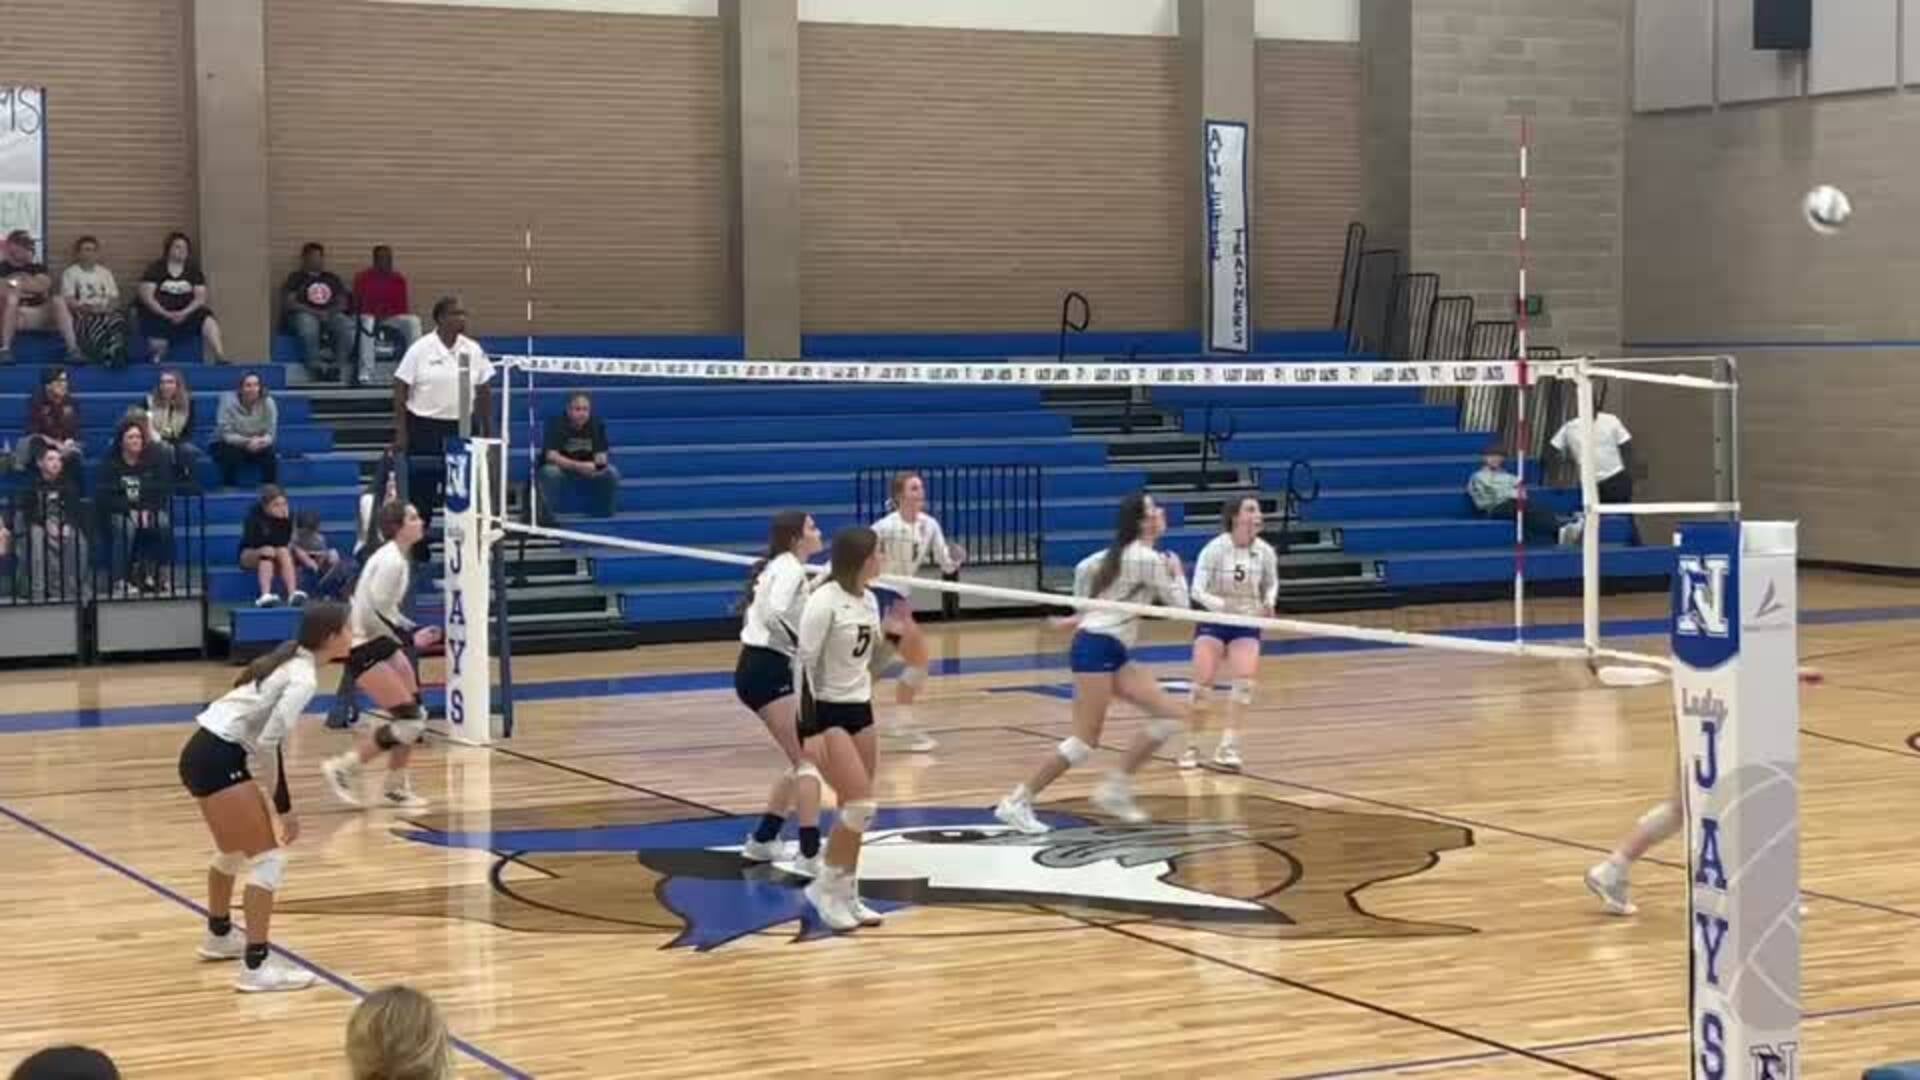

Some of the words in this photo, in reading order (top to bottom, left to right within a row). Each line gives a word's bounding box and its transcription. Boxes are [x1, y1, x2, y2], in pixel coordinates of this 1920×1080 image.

[446, 453, 467, 498] N
[1234, 564, 1246, 583] 5
[1677, 555, 1730, 638] N
[450, 540, 466, 725] JAYS
[852, 624, 871, 657] 5
[1682, 687, 1729, 733] Lady
[1694, 720, 1729, 1080] JAYS
